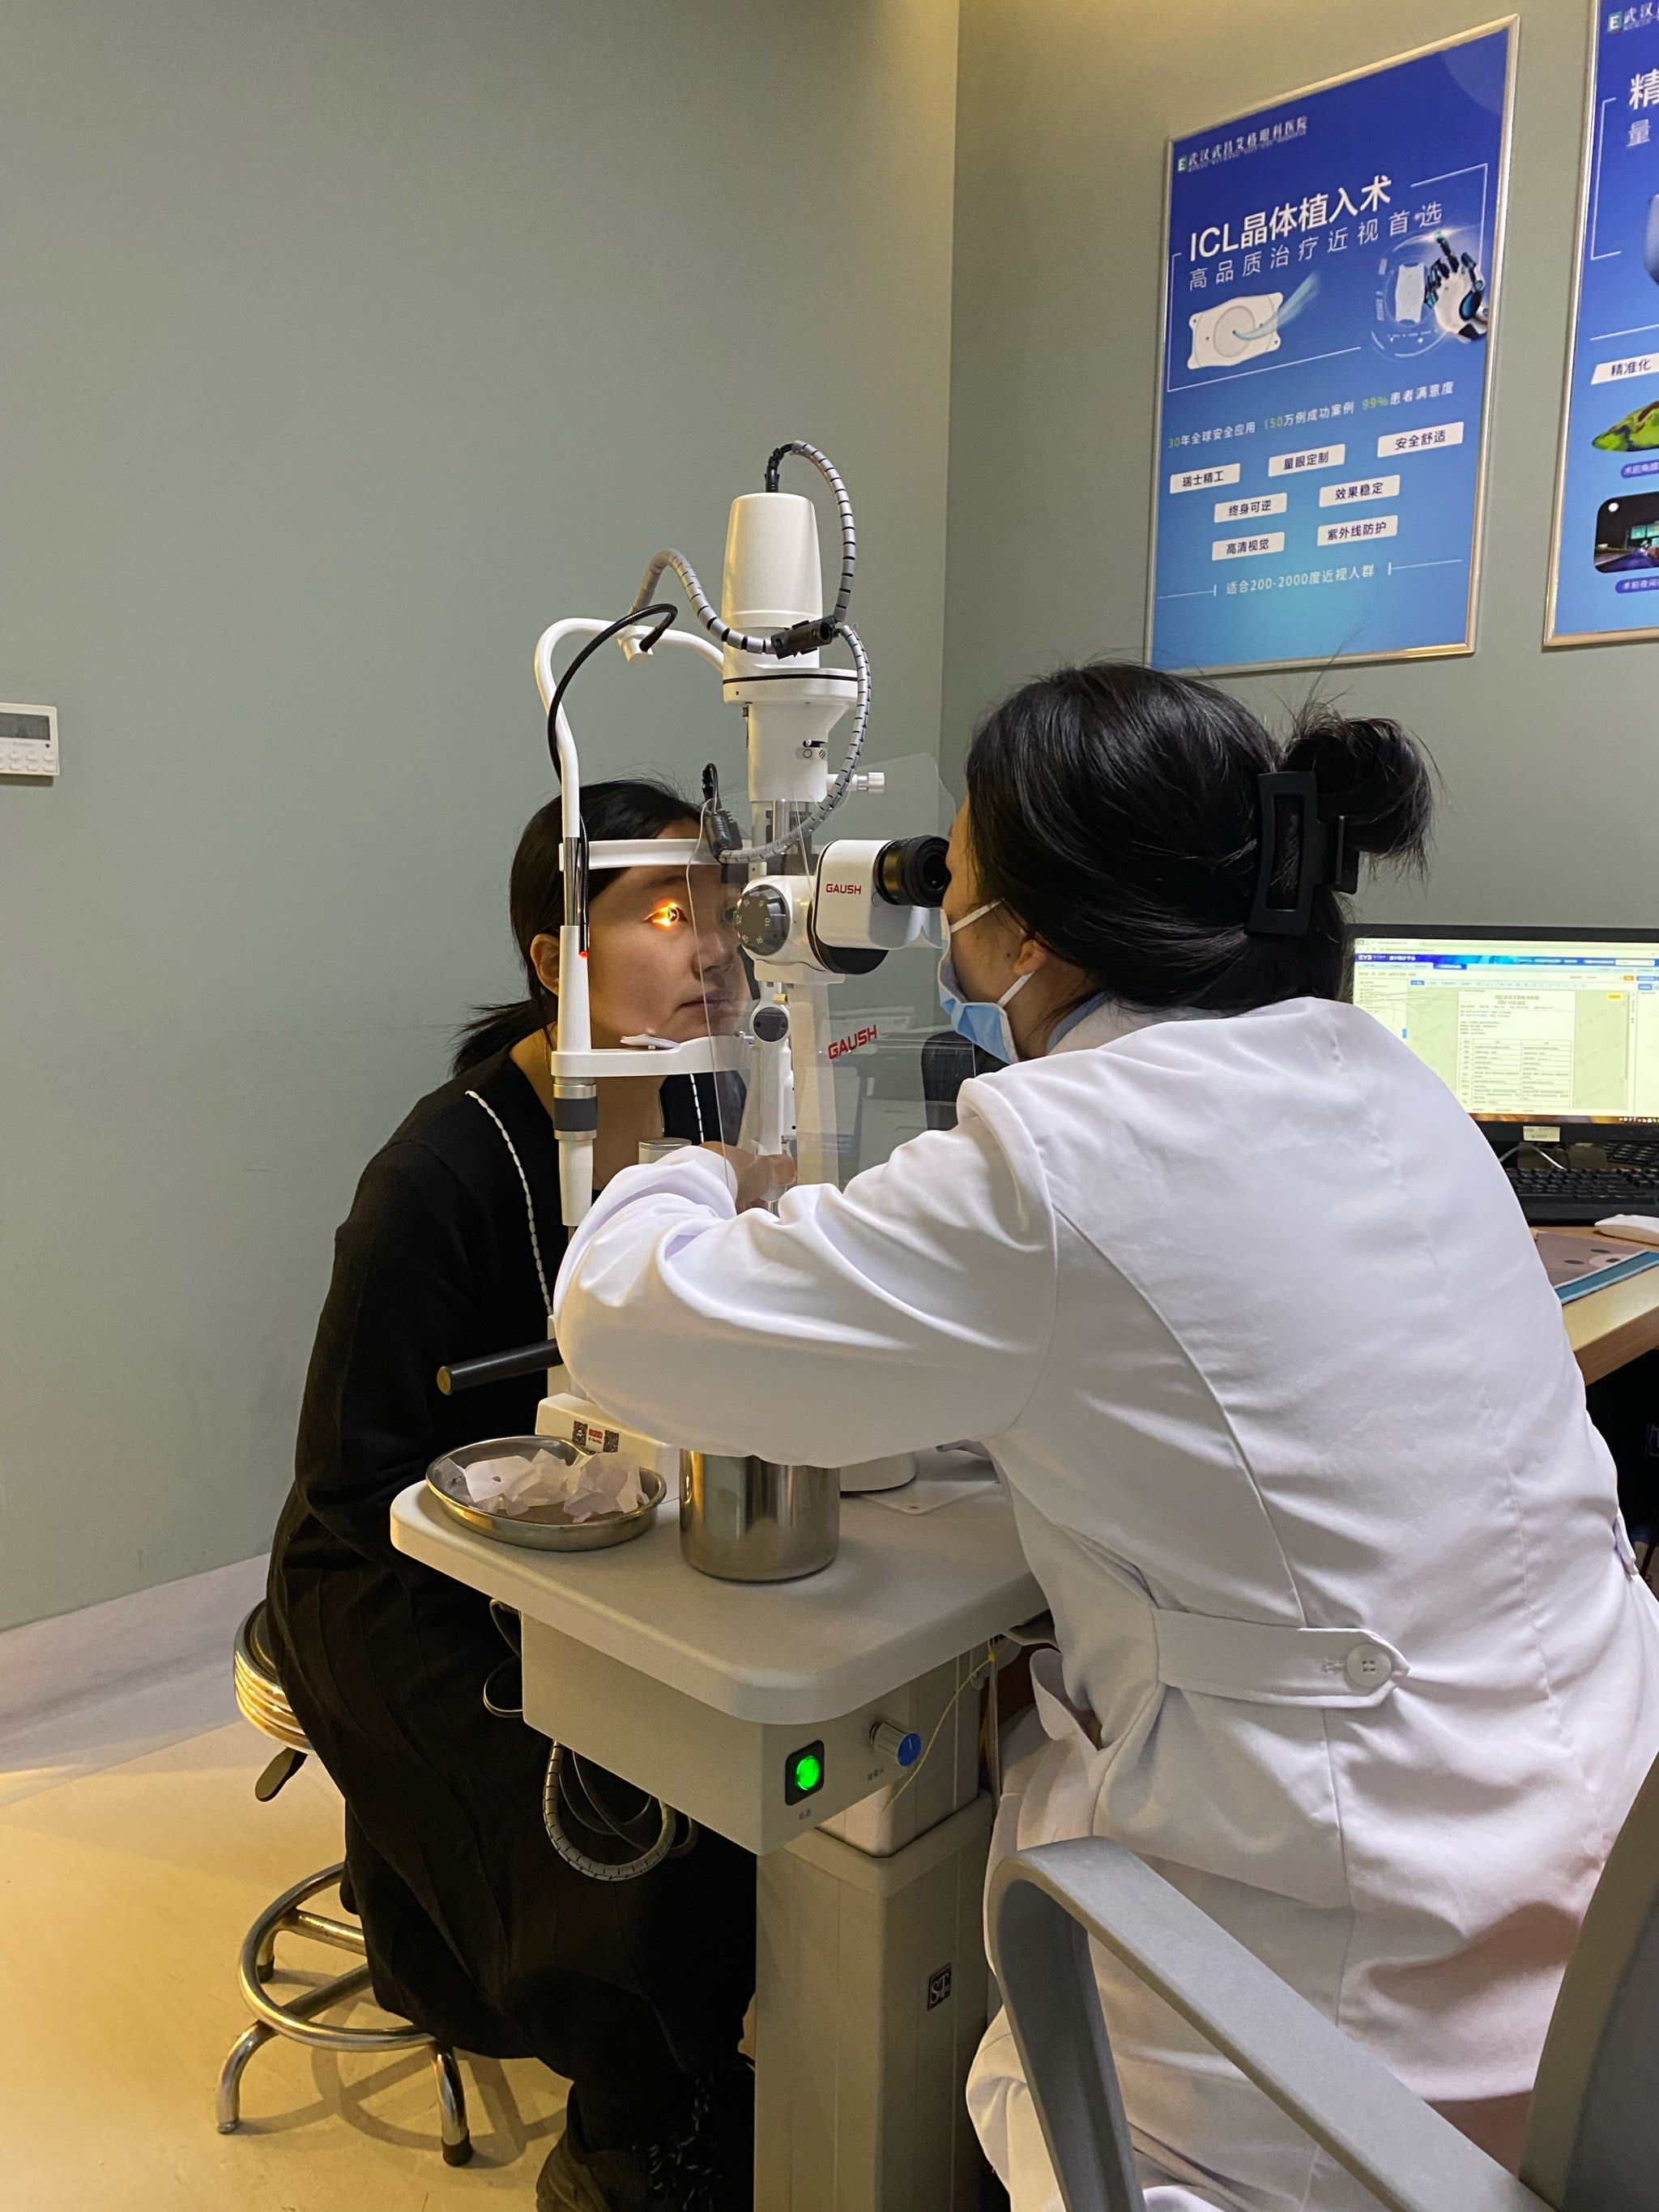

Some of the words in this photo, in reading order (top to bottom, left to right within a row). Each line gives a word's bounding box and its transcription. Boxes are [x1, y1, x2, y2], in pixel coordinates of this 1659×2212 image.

[1623, 2, 1659, 25] 武汉
[1627, 119, 1651, 147] 量
[1190, 174, 1392, 262] ICL晶体植入术
[1611, 357, 1652, 377] 精准化
[1395, 429, 1447, 451] 安全舒适
[1283, 450, 1329, 470] 量眼定制
[1182, 471, 1224, 488] 瑞士精工
[1335, 481, 1384, 501] 效果稳定
[1228, 500, 1272, 517] 终身可逆
[1327, 521, 1387, 541] 紫外线防护
[1226, 539, 1269, 556] 高清视觉
[826, 883, 862, 895] GAUSH
[764, 917, 771, 927] 10
[828, 1024, 877, 1060] GAUSH
